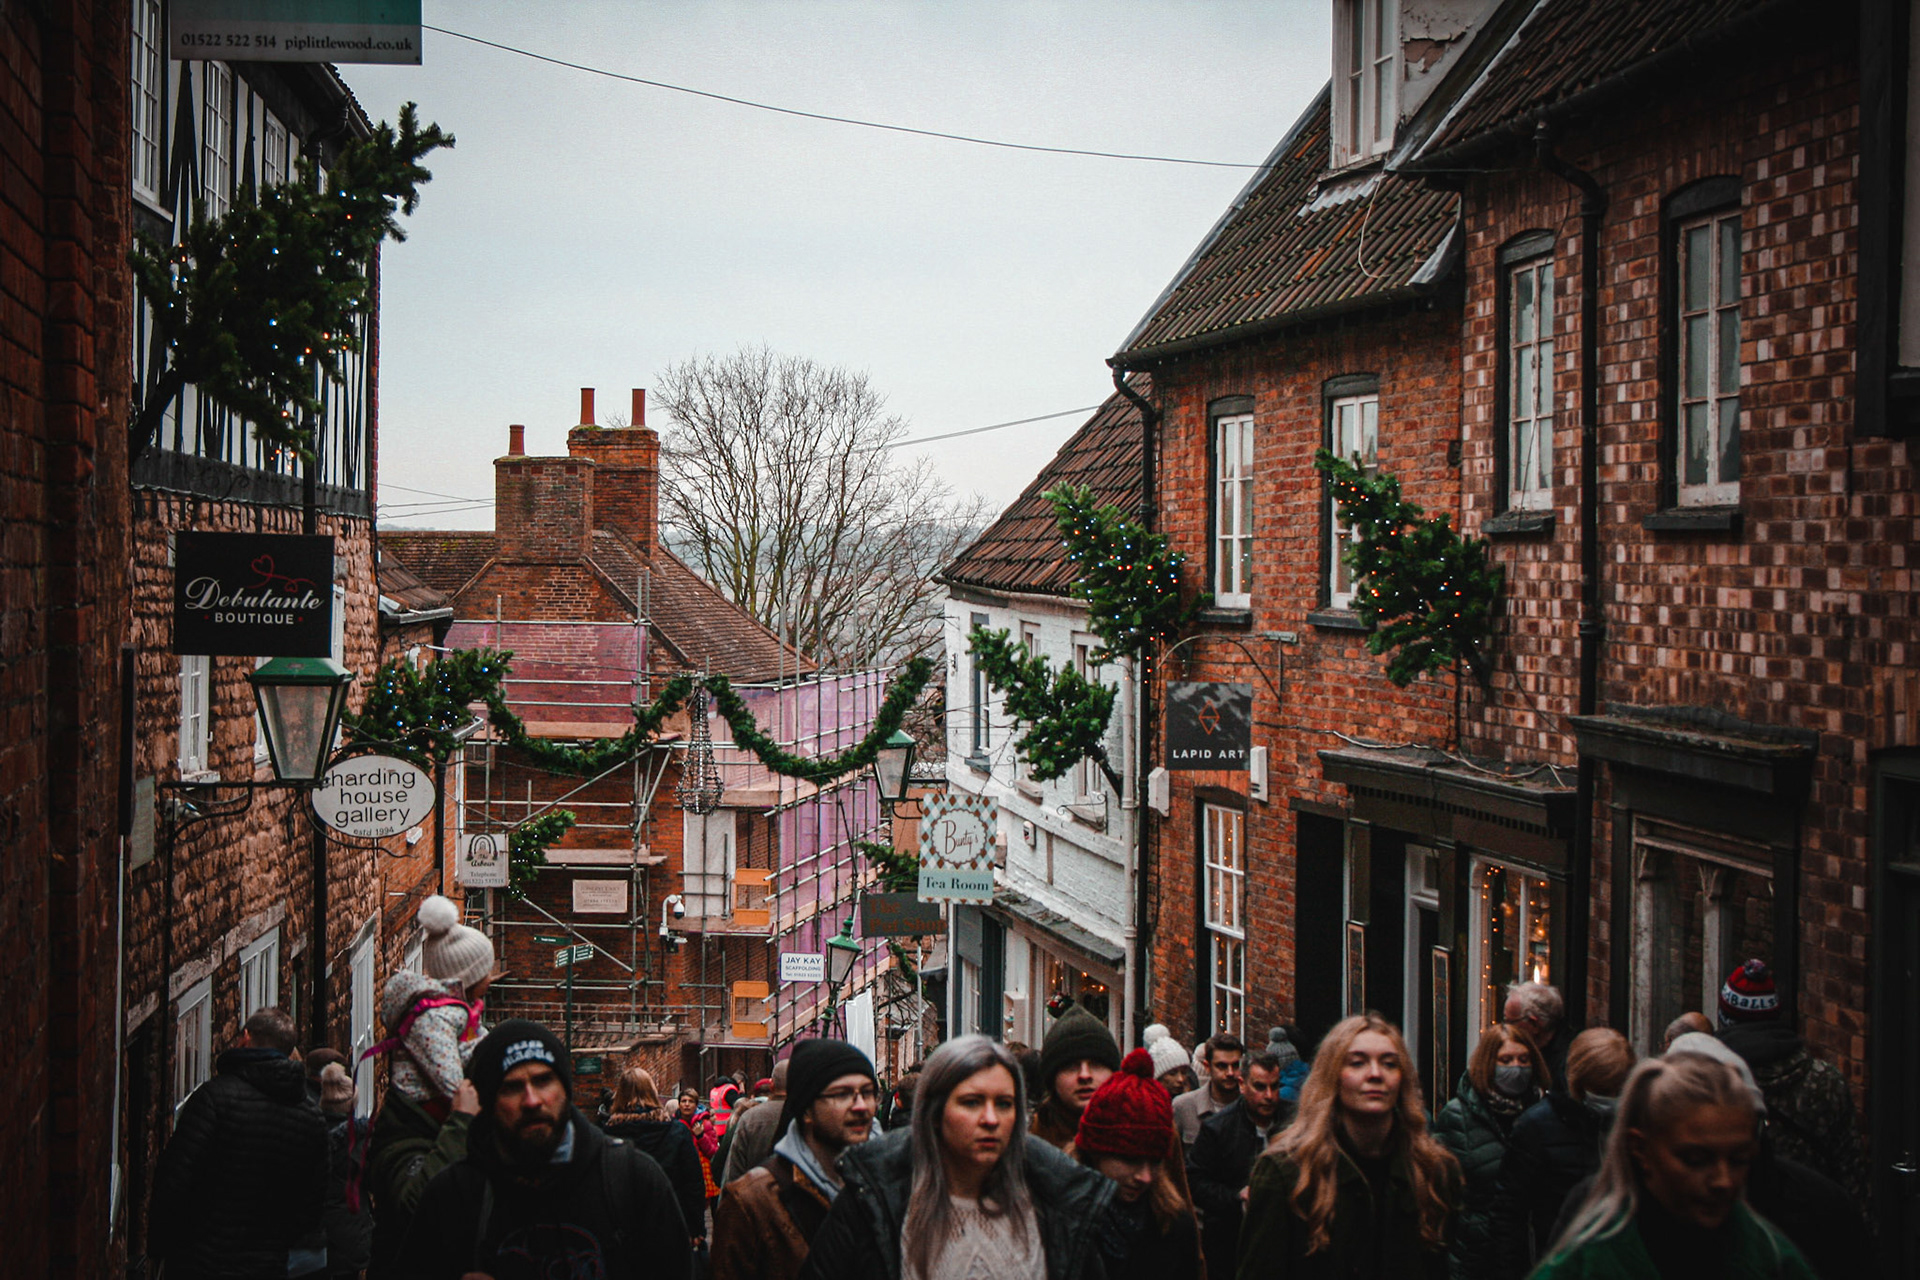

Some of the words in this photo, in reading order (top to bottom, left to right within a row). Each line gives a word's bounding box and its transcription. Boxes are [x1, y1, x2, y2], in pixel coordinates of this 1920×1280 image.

[181, 33, 221, 47] 01522
[226, 34, 250, 47] 522
[254, 35, 277, 48] 514
[285, 36, 413, 50] piplittlewood.co.uk
[185, 576, 324, 610] Debutante
[215, 612, 294, 625] BOUTIQUE
[1172, 749, 1212, 758] LAPID
[1219, 749, 1244, 758] ART
[331, 768, 416, 789] harding
[340, 788, 408, 805] house
[335, 806, 411, 828] gallery
[375, 826, 395, 836] 1994
[941, 819, 979, 857] Bunty's
[923, 876, 946, 889] Tea
[951, 877, 989, 891] Room
[869, 899, 901, 914] The
[902, 917, 948, 934] Shop
